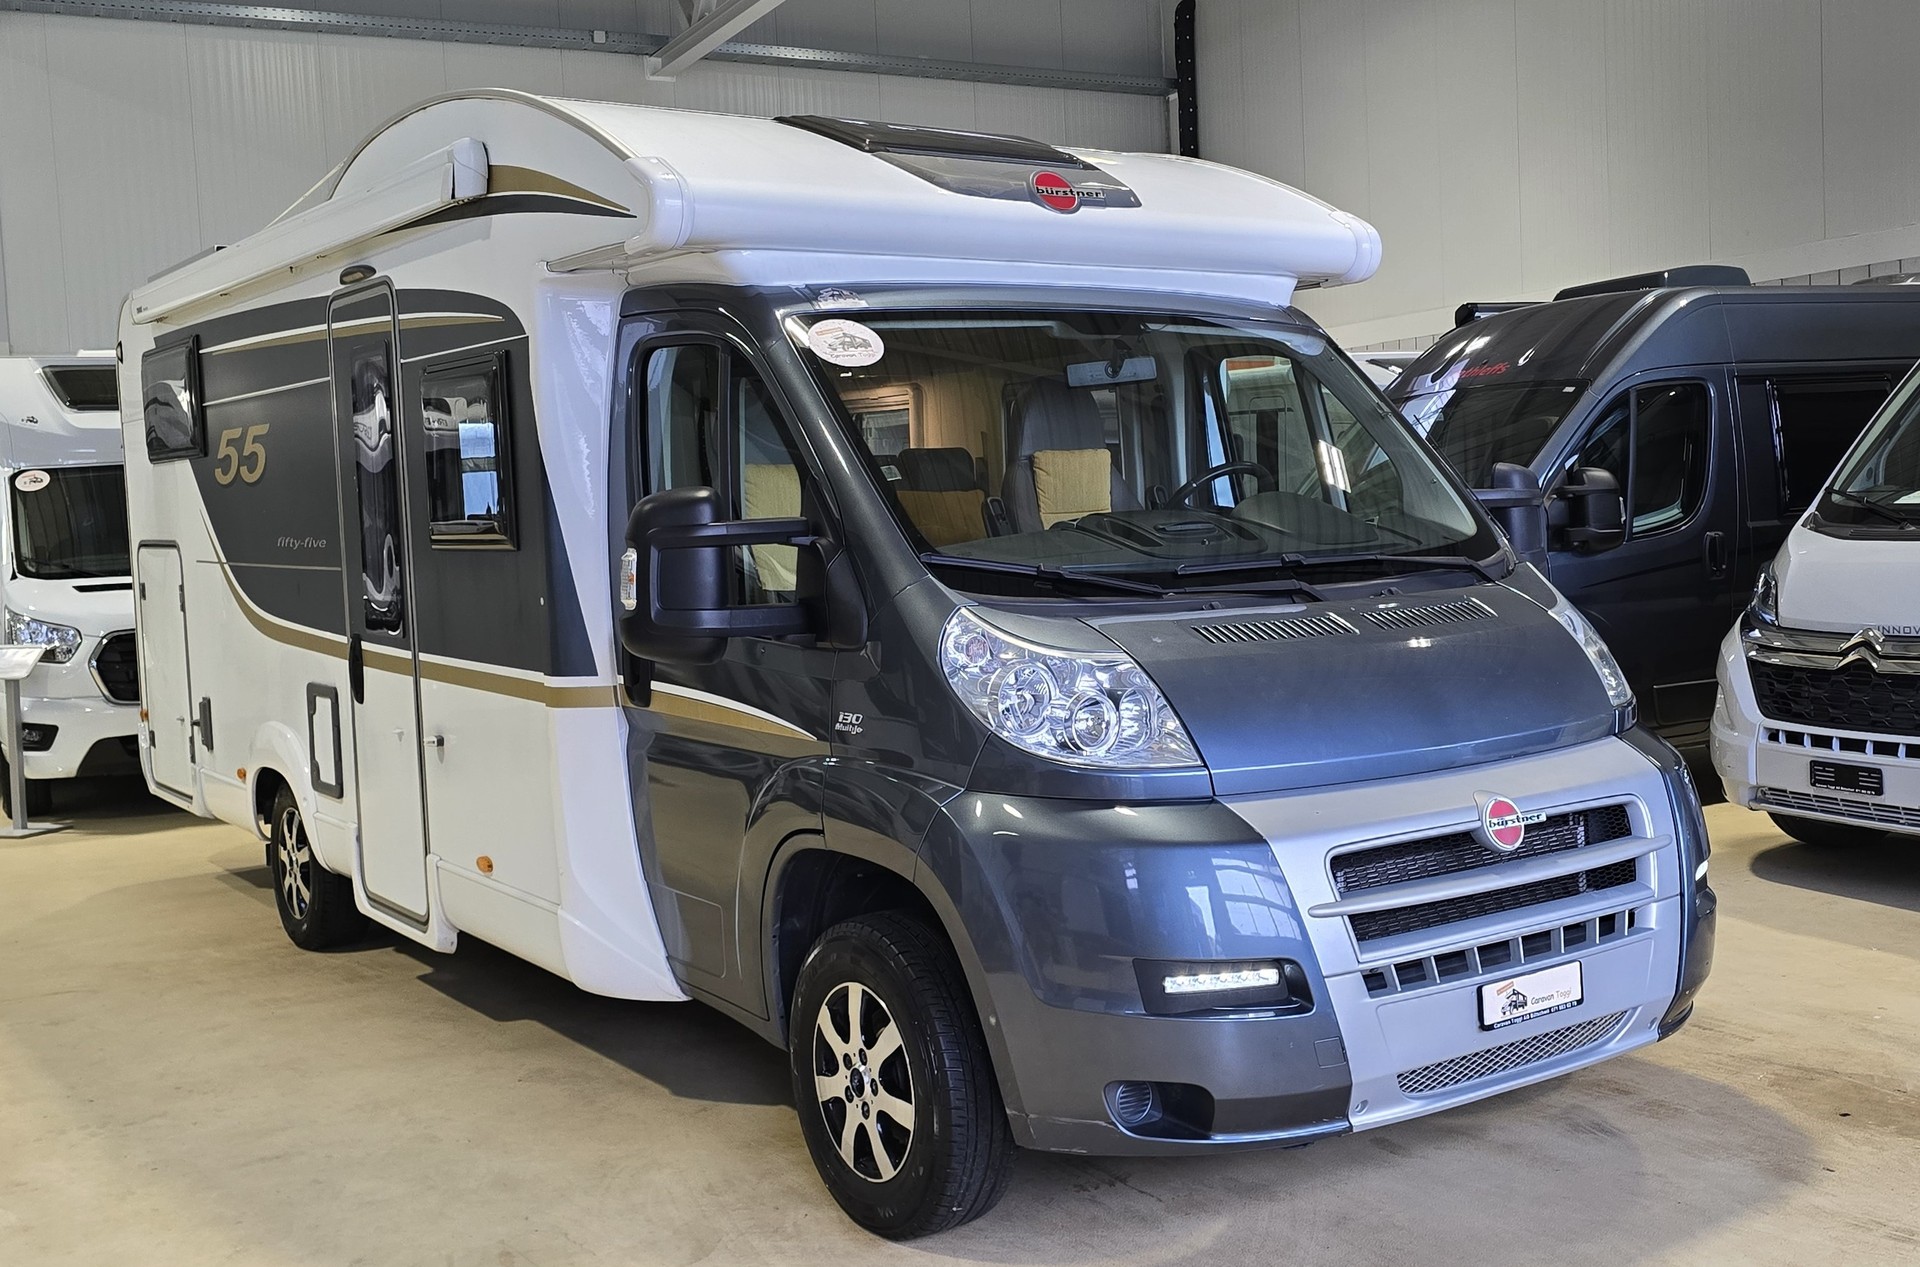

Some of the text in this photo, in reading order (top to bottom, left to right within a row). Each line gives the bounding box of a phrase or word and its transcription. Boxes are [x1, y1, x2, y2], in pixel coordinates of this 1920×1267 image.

[1036, 186, 1102, 198] bürstner
[214, 423, 270, 485] 55
[277, 536, 327, 550] fifty-five
[1488, 813, 1542, 828] bürstner
[1530, 993, 1555, 1005] Caravan
